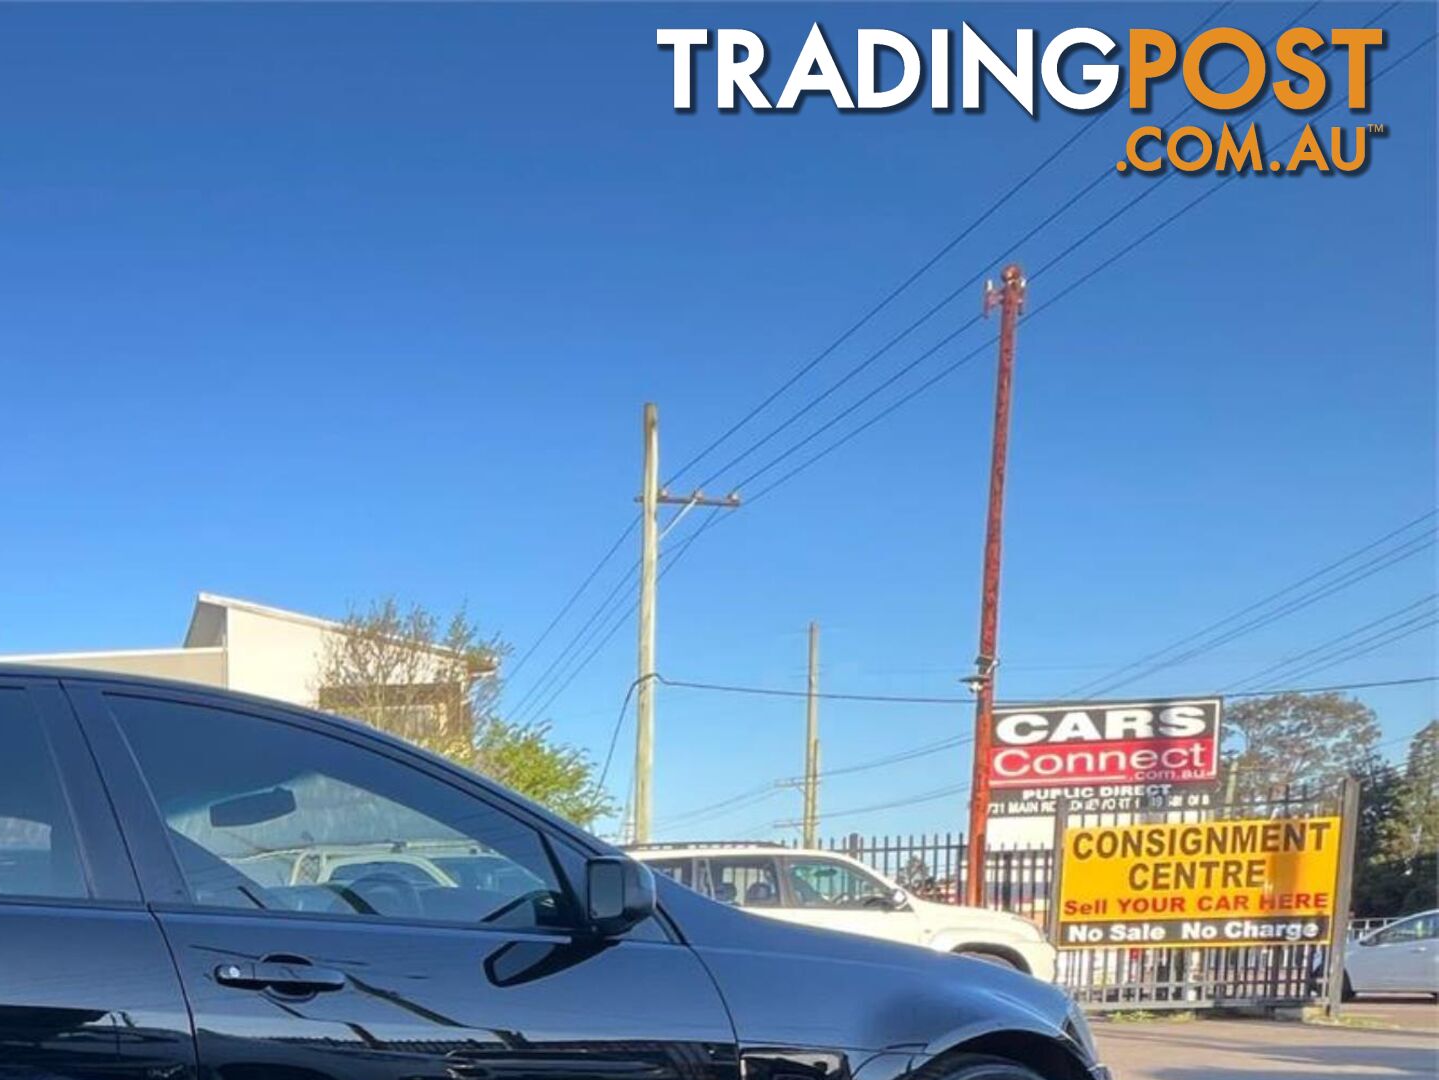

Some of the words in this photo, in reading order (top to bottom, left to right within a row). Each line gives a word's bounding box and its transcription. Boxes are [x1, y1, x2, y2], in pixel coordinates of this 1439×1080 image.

[995, 706, 1207, 745] CARS
[993, 743, 1207, 777] Connect
[1128, 769, 1207, 781] .com.au
[1099, 784, 1172, 798] DIRECT
[1072, 822, 1331, 860] CONSIGNMENT
[1128, 859, 1267, 891] CENTRE
[1063, 899, 1108, 916] Sell
[1117, 896, 1186, 914] YOUR
[1197, 894, 1250, 911] CAR
[1258, 892, 1330, 910] HERE
[1068, 924, 1104, 943] No
[1109, 922, 1167, 941] Sale
[1181, 921, 1218, 940] No
[1223, 919, 1319, 941] Charge
